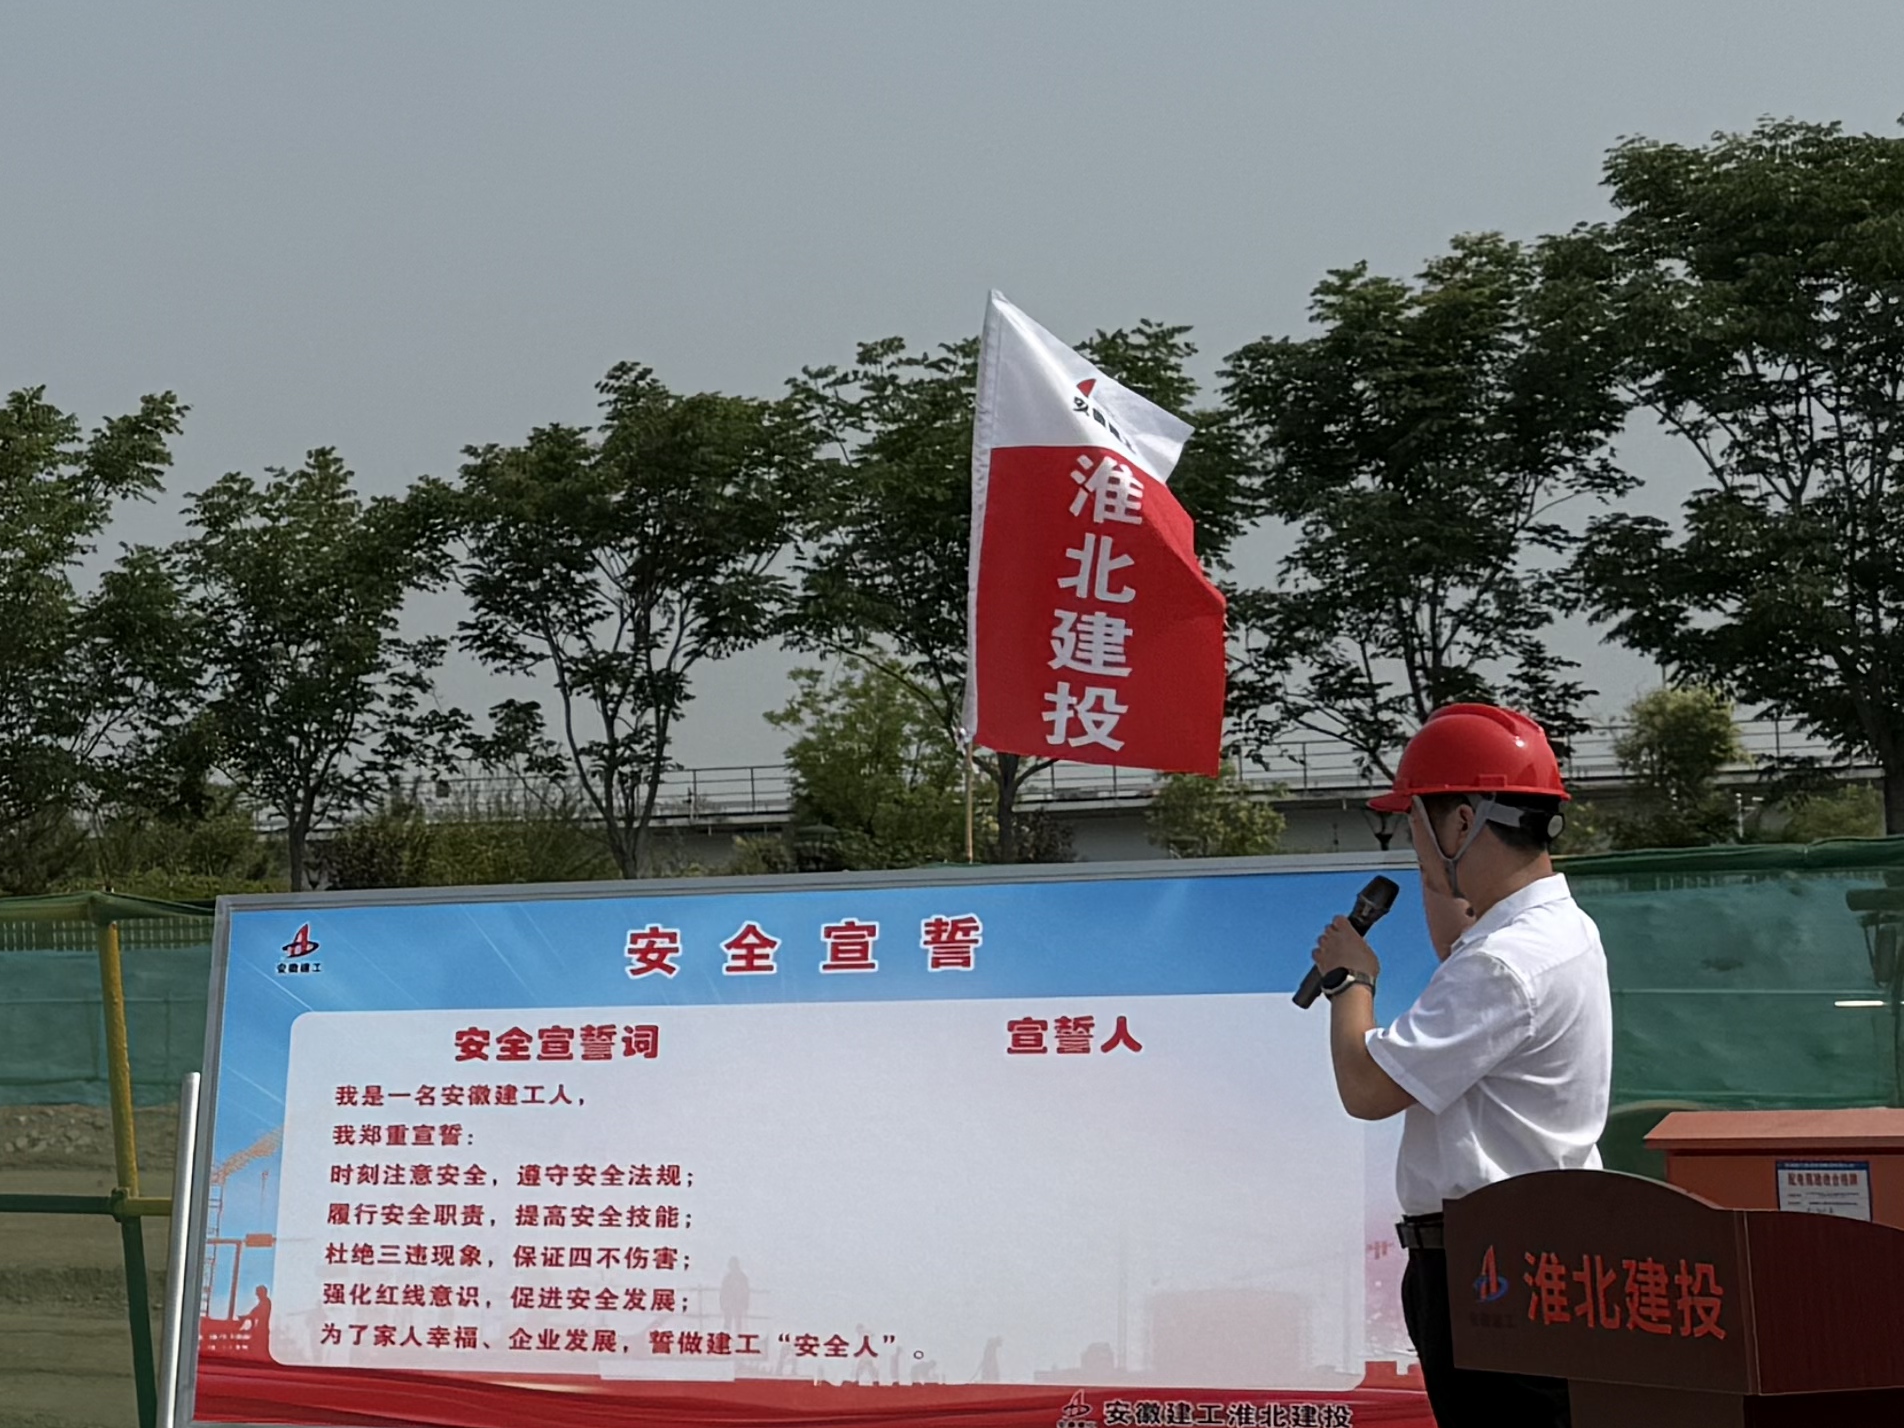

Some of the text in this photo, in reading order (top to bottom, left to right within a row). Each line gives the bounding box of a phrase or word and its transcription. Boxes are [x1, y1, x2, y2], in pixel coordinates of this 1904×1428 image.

[1041, 455, 1143, 752] 淮北建投
[627, 916, 980, 976] 安全宣誓
[455, 1025, 659, 1061] 安全宣誓词
[1007, 1015, 1143, 1055] 宣誓人
[335, 1084, 586, 1108] 我是一名安徽建工人，
[333, 1124, 474, 1147] 我郑重宣誓：
[1524, 1252, 1727, 1340] 淮北建投
